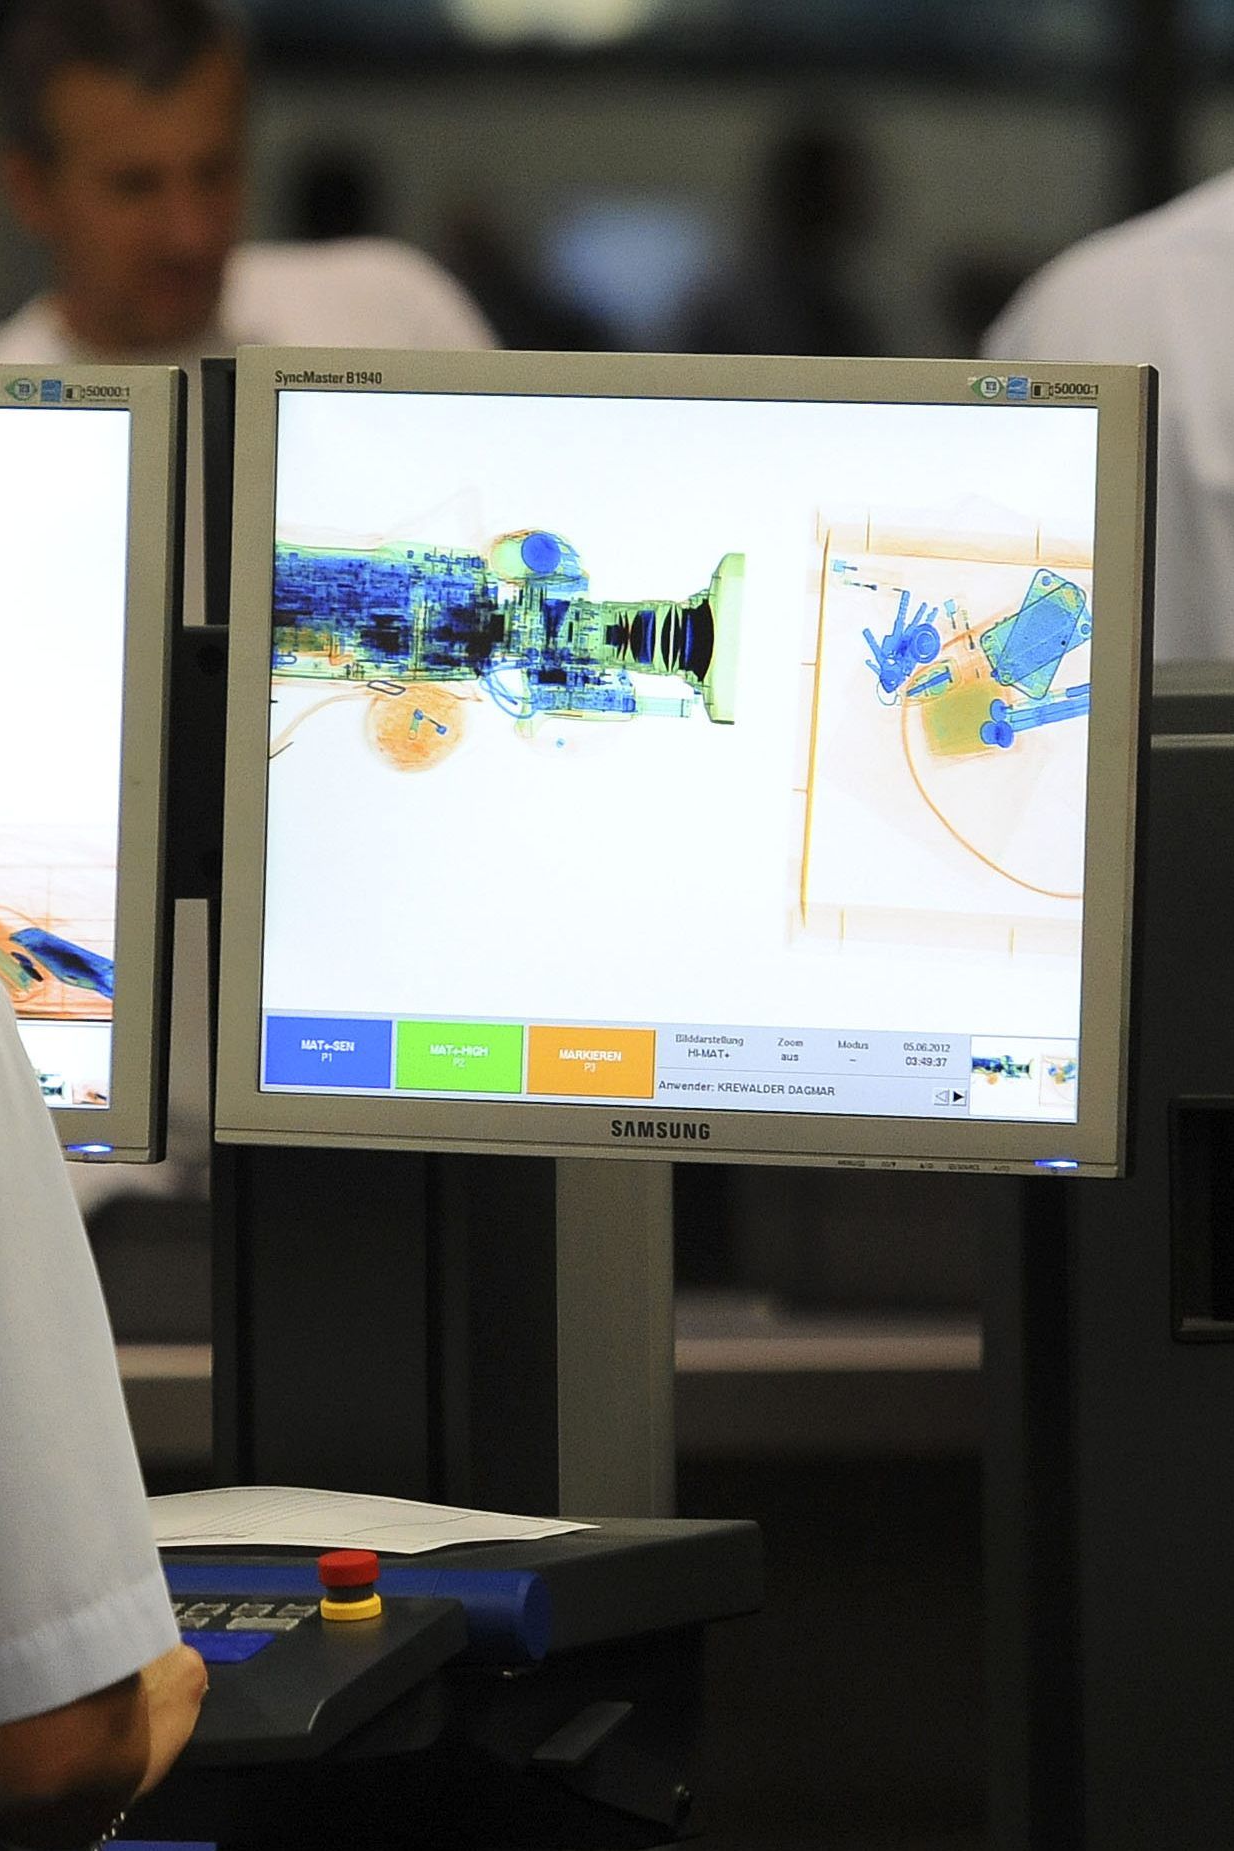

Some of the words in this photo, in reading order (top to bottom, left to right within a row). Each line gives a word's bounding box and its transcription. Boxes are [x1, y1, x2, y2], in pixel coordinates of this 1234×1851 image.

[275, 370, 344, 386] SyncMaster
[346, 372, 382, 385] B1940
[1055, 383, 1099, 395] 50000:1
[675, 1033, 744, 1047] Bilddarstellung
[777, 1037, 804, 1047] Zoom
[837, 1040, 869, 1050] Modus
[903, 1042, 951, 1053] 05.06.2012
[321, 1053, 333, 1063] P1
[559, 1048, 622, 1061] MARKIEREN
[781, 1053, 799, 1062] aus
[905, 1056, 948, 1067] 03:49:37
[658, 1080, 715, 1092] Anwender:
[717, 1082, 785, 1095] KREWALDER
[788, 1085, 835, 1097] DAGMAR
[611, 1119, 711, 1140] SAMSUNG
